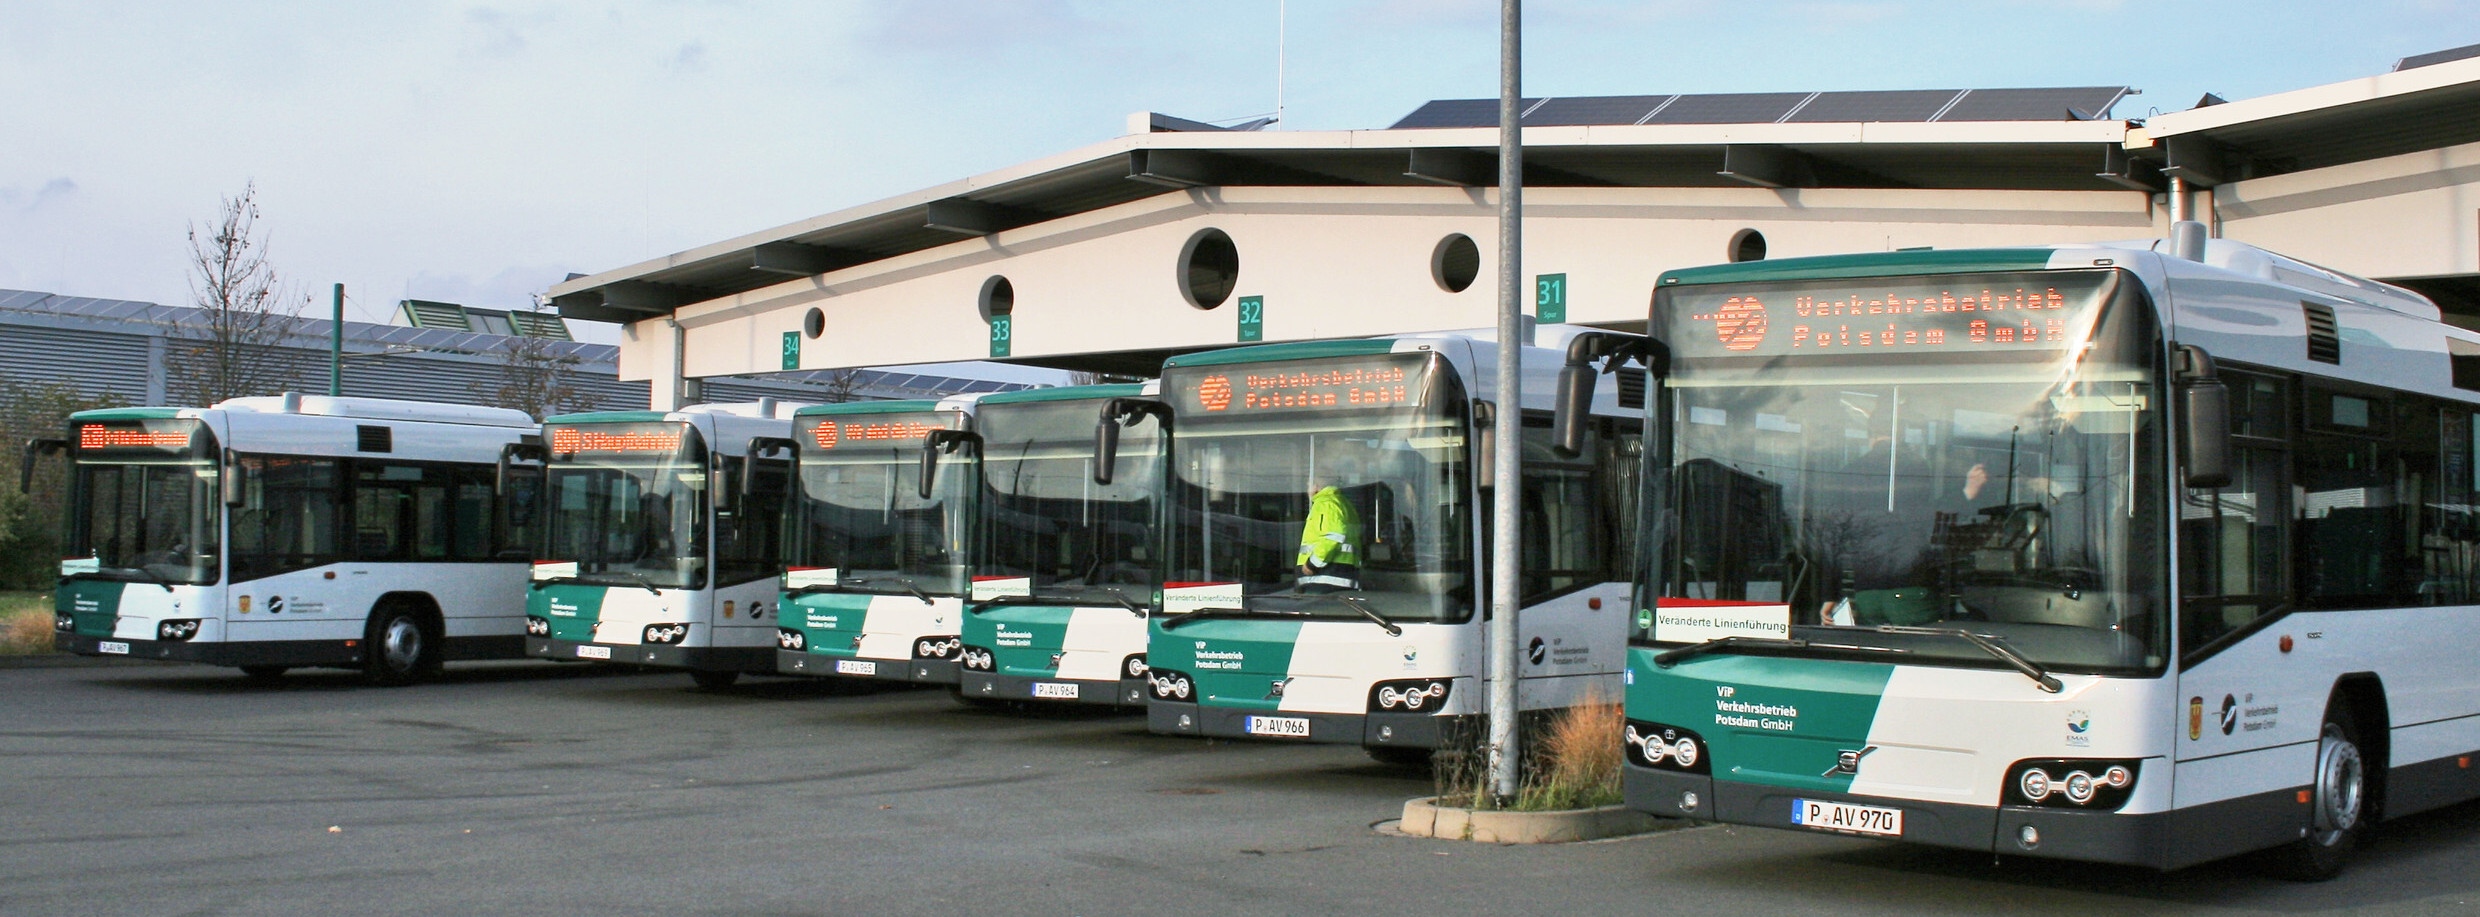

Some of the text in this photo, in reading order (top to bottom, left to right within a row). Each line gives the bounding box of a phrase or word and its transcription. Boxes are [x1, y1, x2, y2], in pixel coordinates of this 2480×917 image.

[1538, 280, 1560, 305] 31
[1797, 287, 2063, 317] Verkehrsbetrieb
[1240, 301, 1260, 324] 32
[992, 320, 1009, 341] 33
[1793, 318, 2063, 347] Potsdam GmbH
[784, 336, 799, 355] 34
[1247, 367, 1403, 389] Verkehrsbetrieb
[1246, 385, 1405, 408] Potsdam GmbH
[582, 432, 592, 450] S
[1714, 618, 1787, 633] Linienführung
[1195, 651, 1244, 660] Verkehrsbetrieb
[1195, 660, 1242, 669] Potsdam GmbH
[1039, 685, 1075, 696] P AV 964
[1716, 685, 1734, 697] ViP
[1716, 700, 1797, 717] Verkehrsbetrieb
[1256, 719, 1305, 734] P AV 966
[1715, 714, 1793, 731] Potsdam GmbH
[1810, 804, 1893, 830] P AV 970
